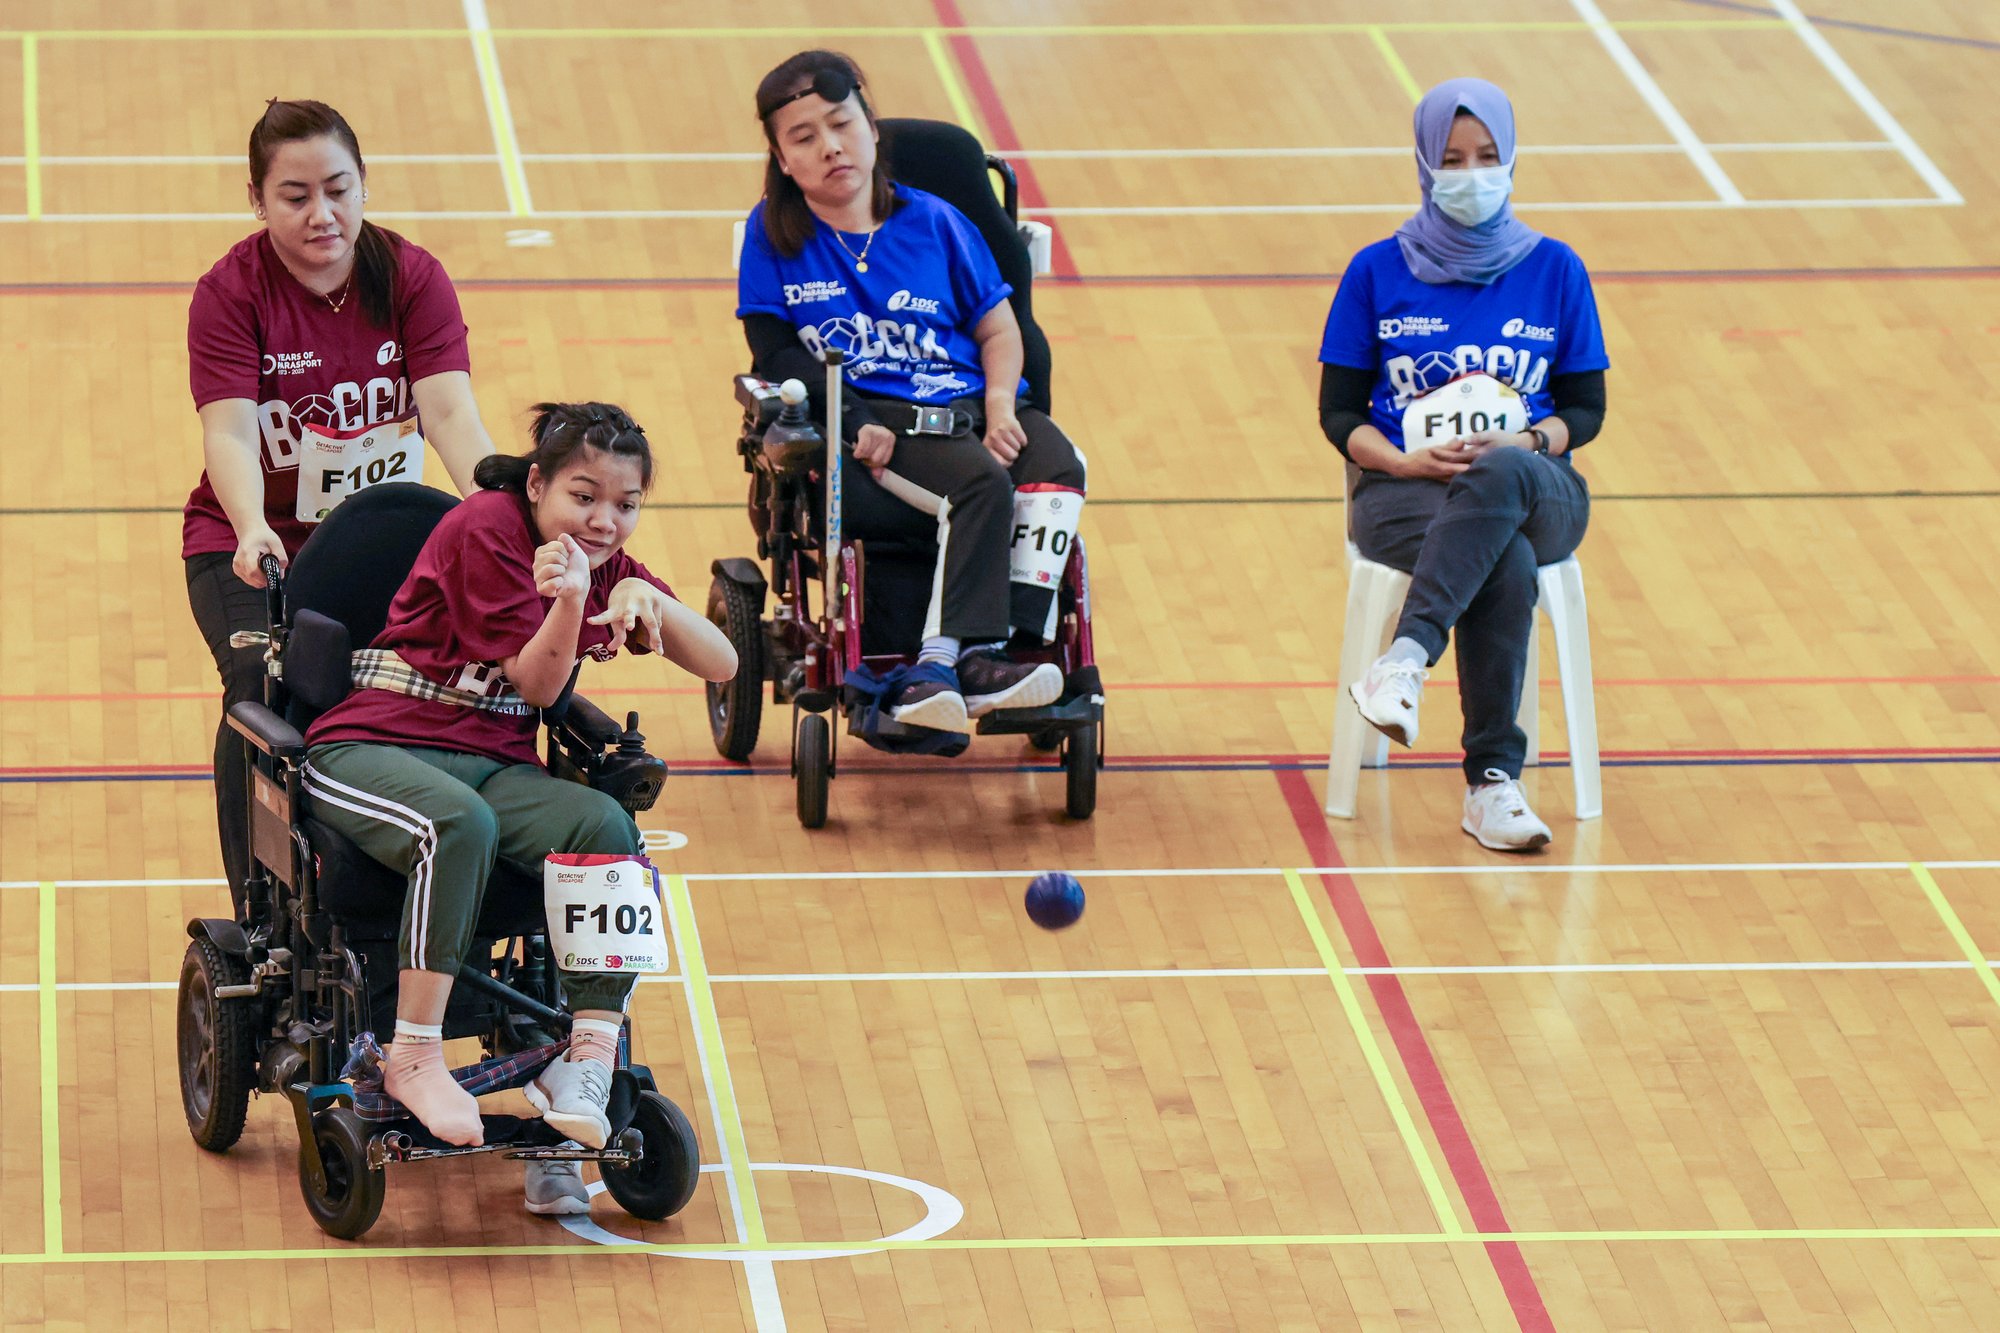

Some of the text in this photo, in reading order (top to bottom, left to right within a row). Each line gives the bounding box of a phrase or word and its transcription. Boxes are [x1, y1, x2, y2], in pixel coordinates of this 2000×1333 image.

[827, 280, 838, 289] OF
[910, 297, 940, 309] SDSC
[1378, 318, 1403, 340] 50
[1429, 317, 1443, 325] OF
[1524, 324, 1555, 337] SDSC
[262, 354, 277, 375] 0
[277, 351, 314, 361] YEARS OF
[258, 376, 415, 473] BOCCI
[1425, 411, 1507, 438] F101
[322, 451, 407, 493] F102
[1010, 524, 1068, 555] F10
[565, 904, 653, 935] F102
[576, 957, 599, 965] SDSC
[605, 955, 623, 968] 50
